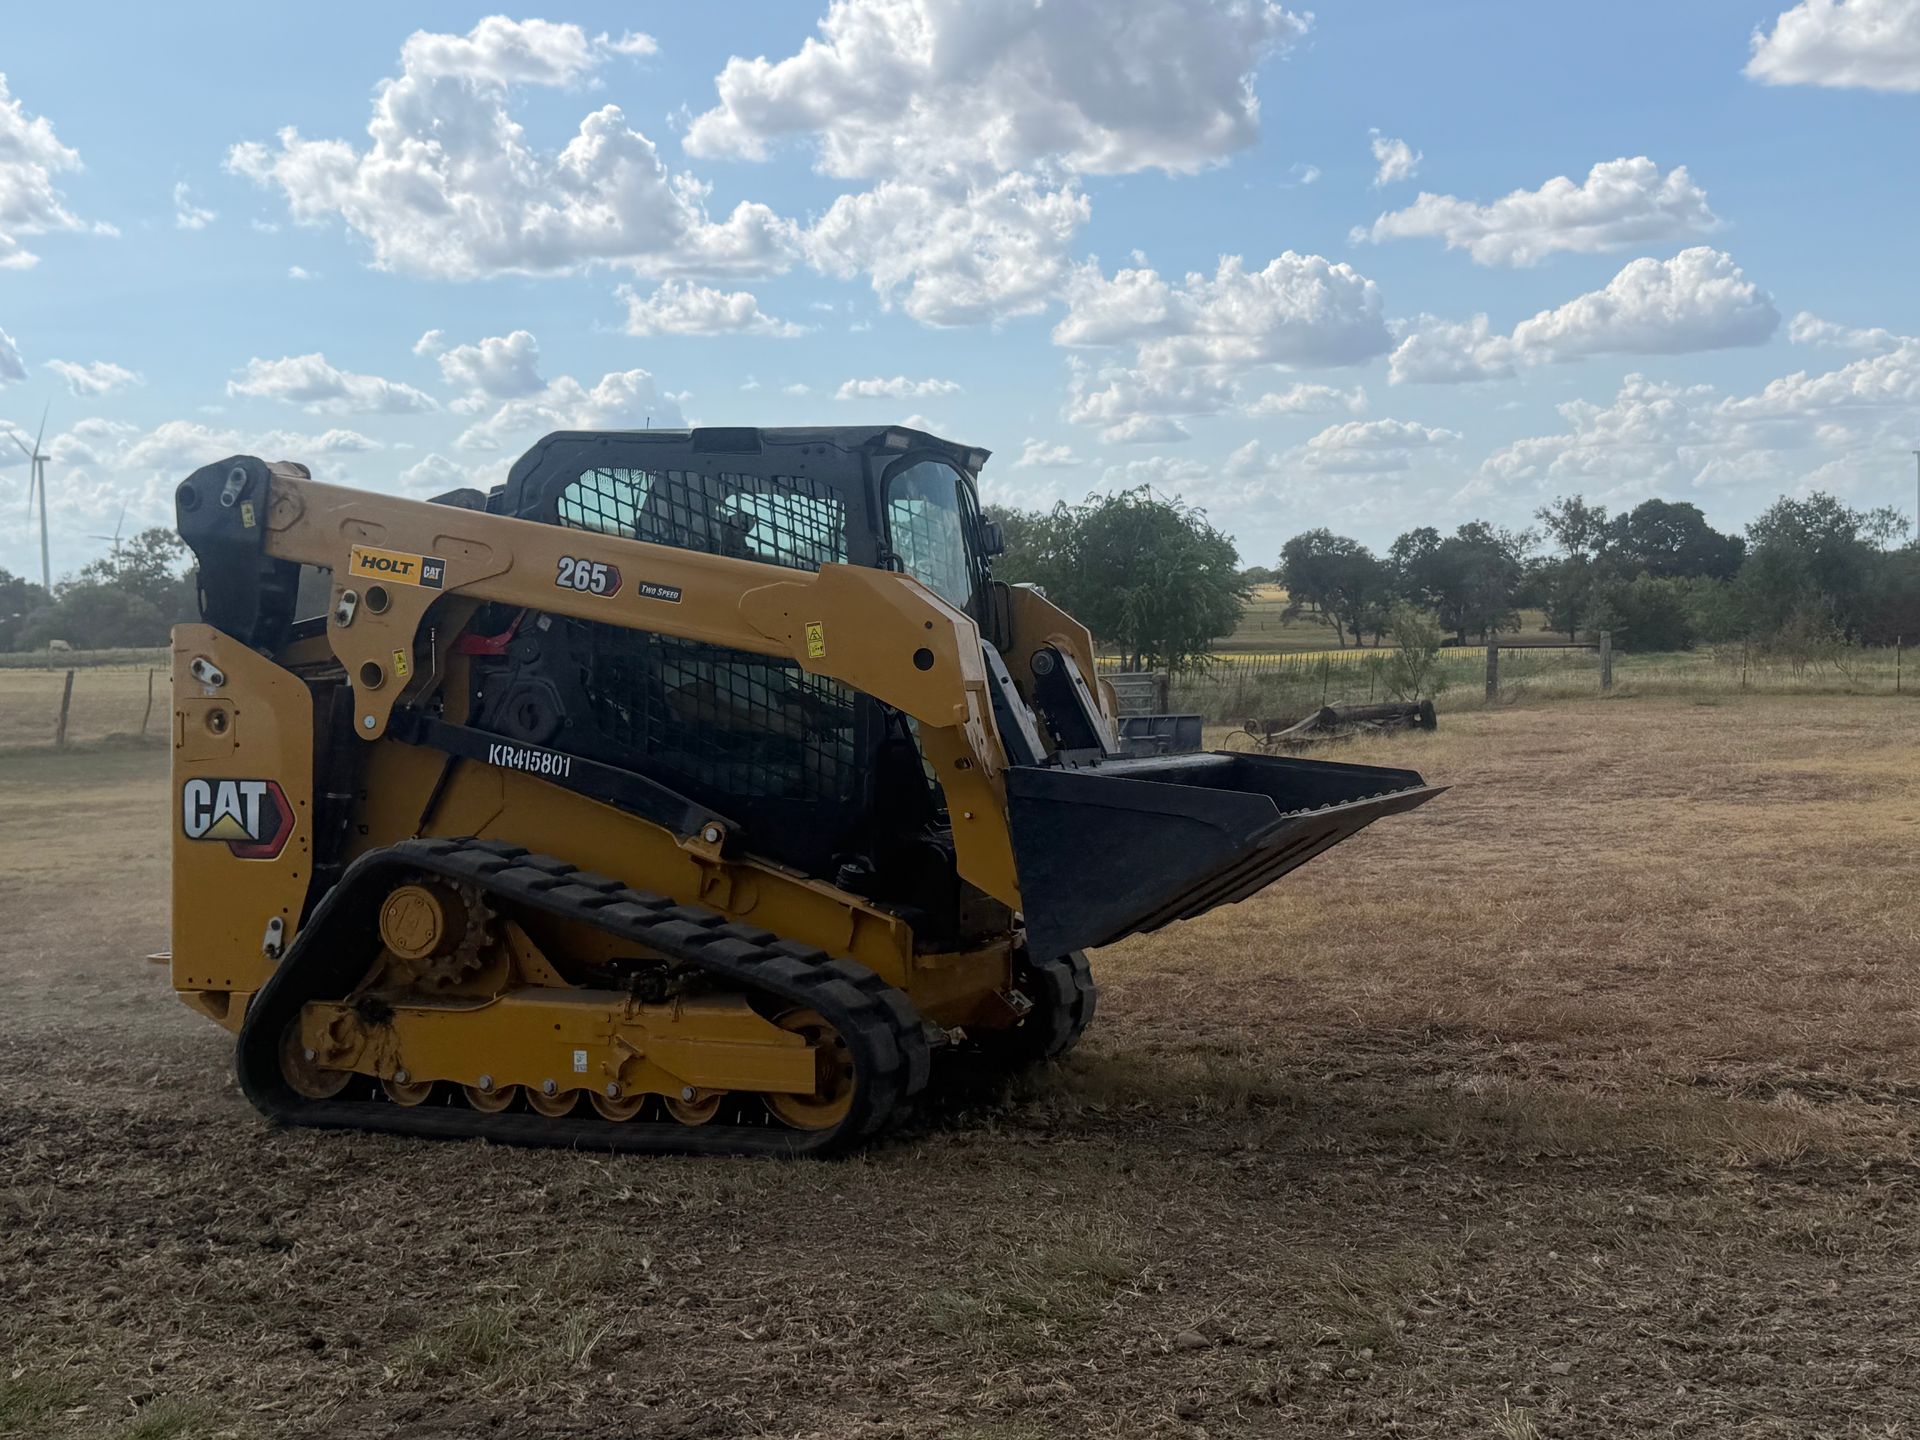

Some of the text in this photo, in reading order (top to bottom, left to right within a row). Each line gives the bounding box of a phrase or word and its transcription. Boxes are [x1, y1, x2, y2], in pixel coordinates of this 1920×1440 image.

[361, 555, 442, 580] HOLT CAT
[556, 556, 608, 593] 265
[488, 743, 571, 778] KR415801
[184, 779, 267, 840] CAT
